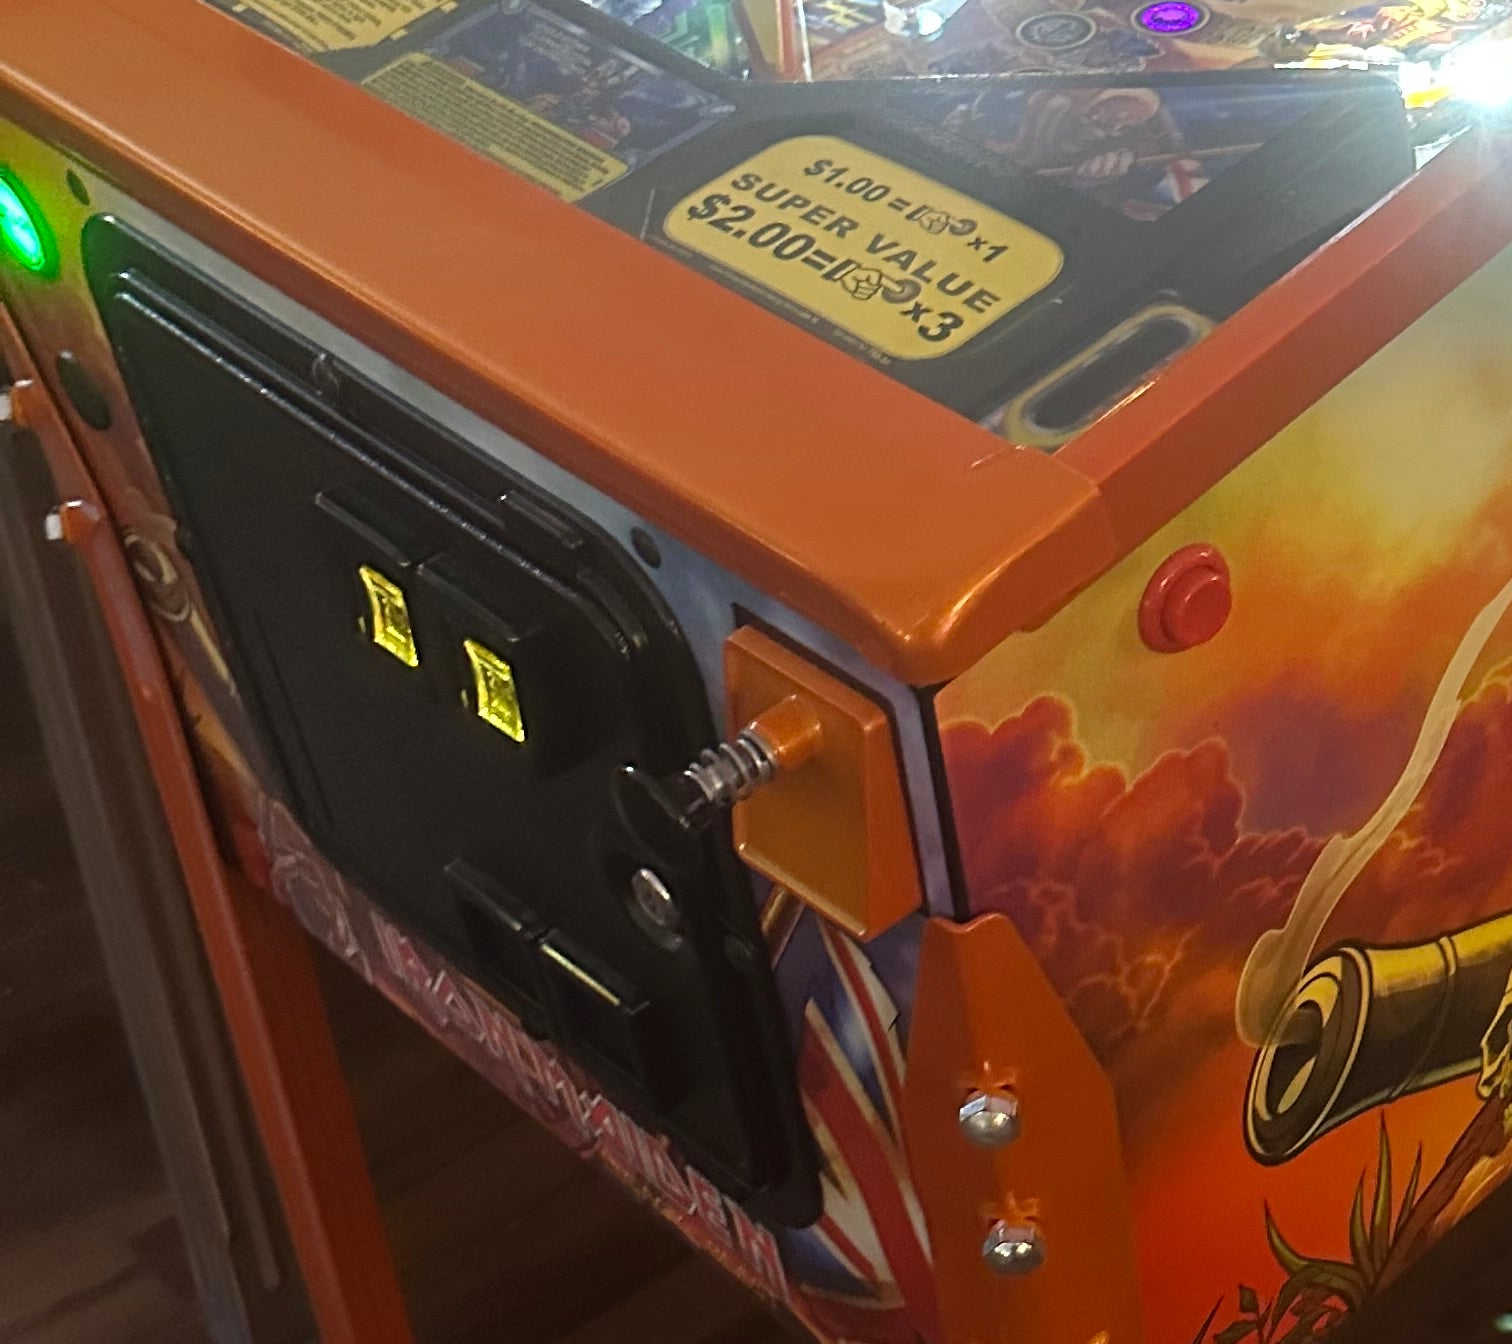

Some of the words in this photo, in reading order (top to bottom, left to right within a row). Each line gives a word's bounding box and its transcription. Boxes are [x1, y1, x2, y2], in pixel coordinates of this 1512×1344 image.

[803, 158, 885, 204] $1.00
[731, 173, 859, 240] SUPER
[866, 233, 1001, 314] VALUE
[899, 300, 965, 343] x3
